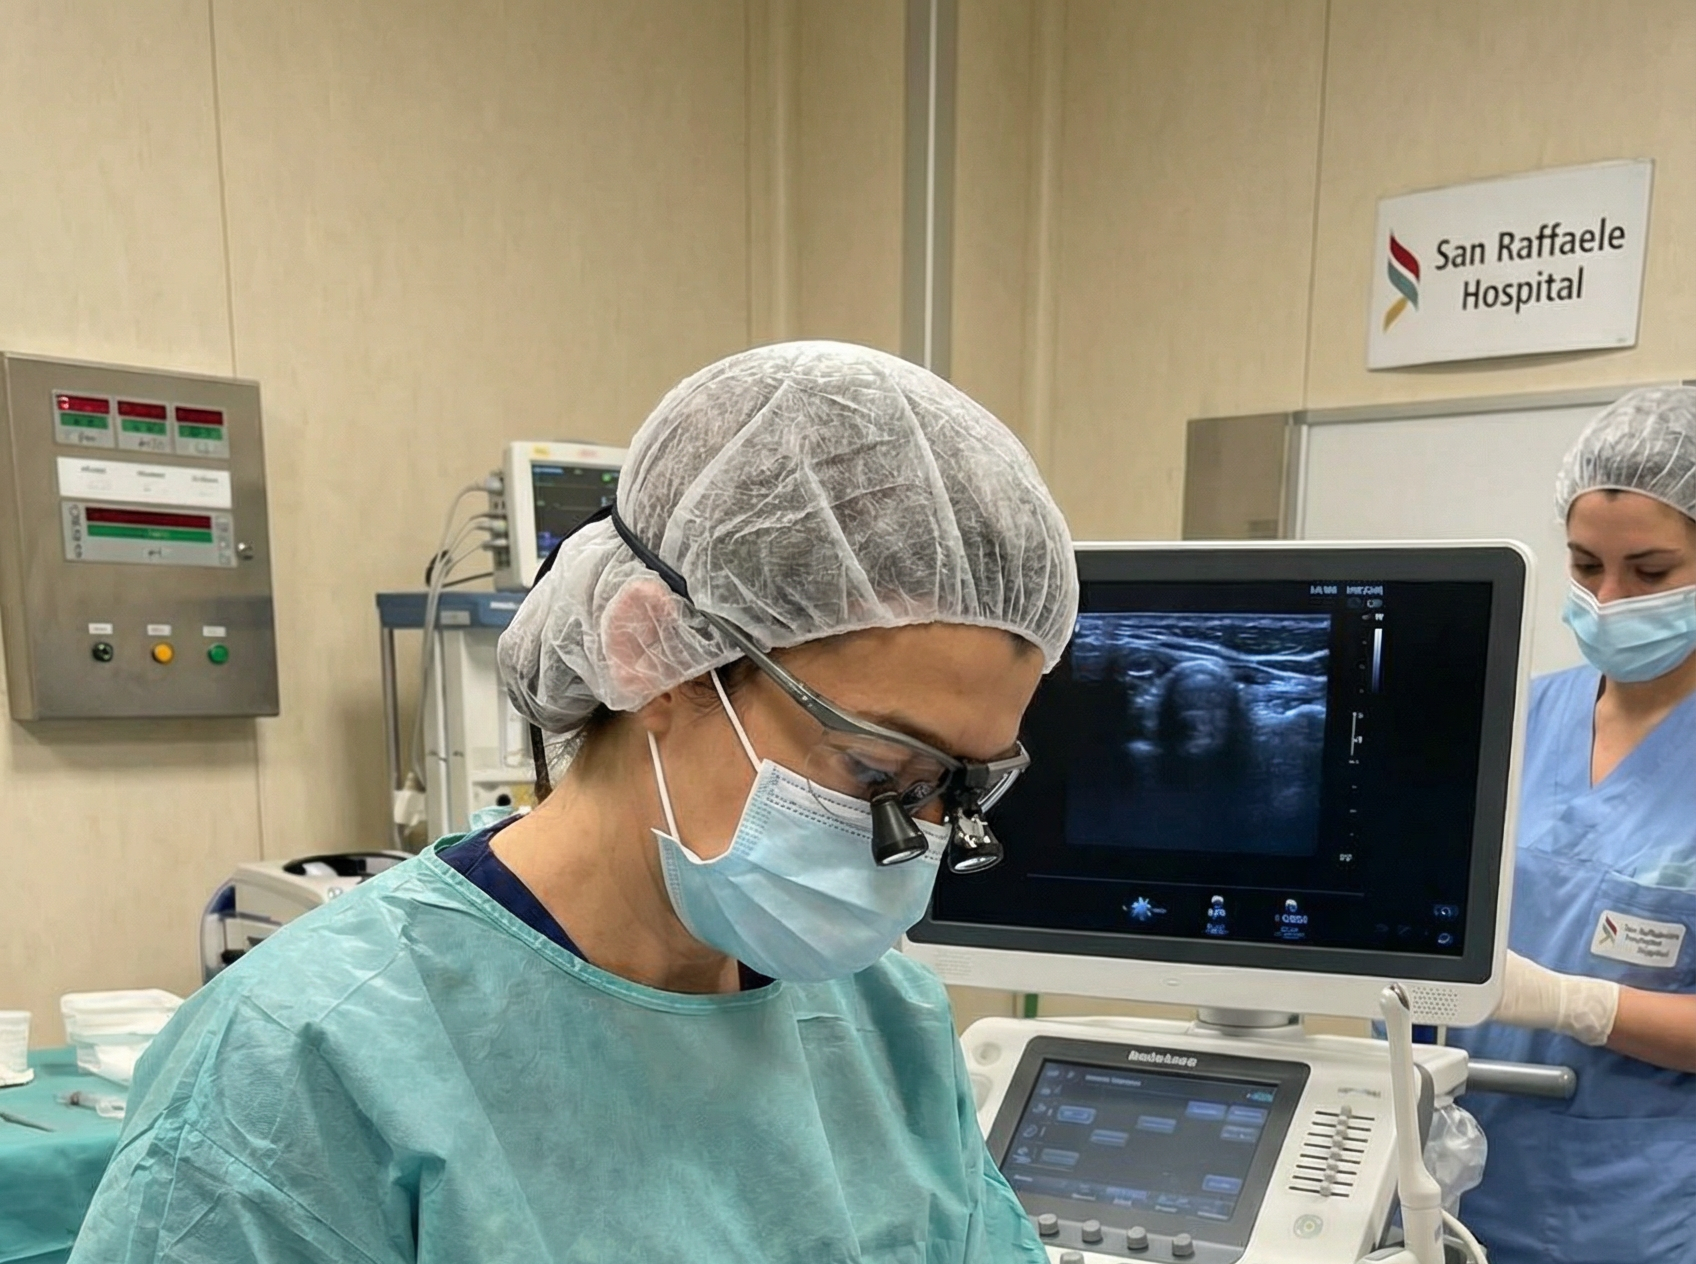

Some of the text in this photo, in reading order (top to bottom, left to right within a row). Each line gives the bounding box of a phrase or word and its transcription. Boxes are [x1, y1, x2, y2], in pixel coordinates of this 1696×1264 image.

[1435, 217, 1626, 271] San Raffaele
[1461, 265, 1584, 315] Hospital
